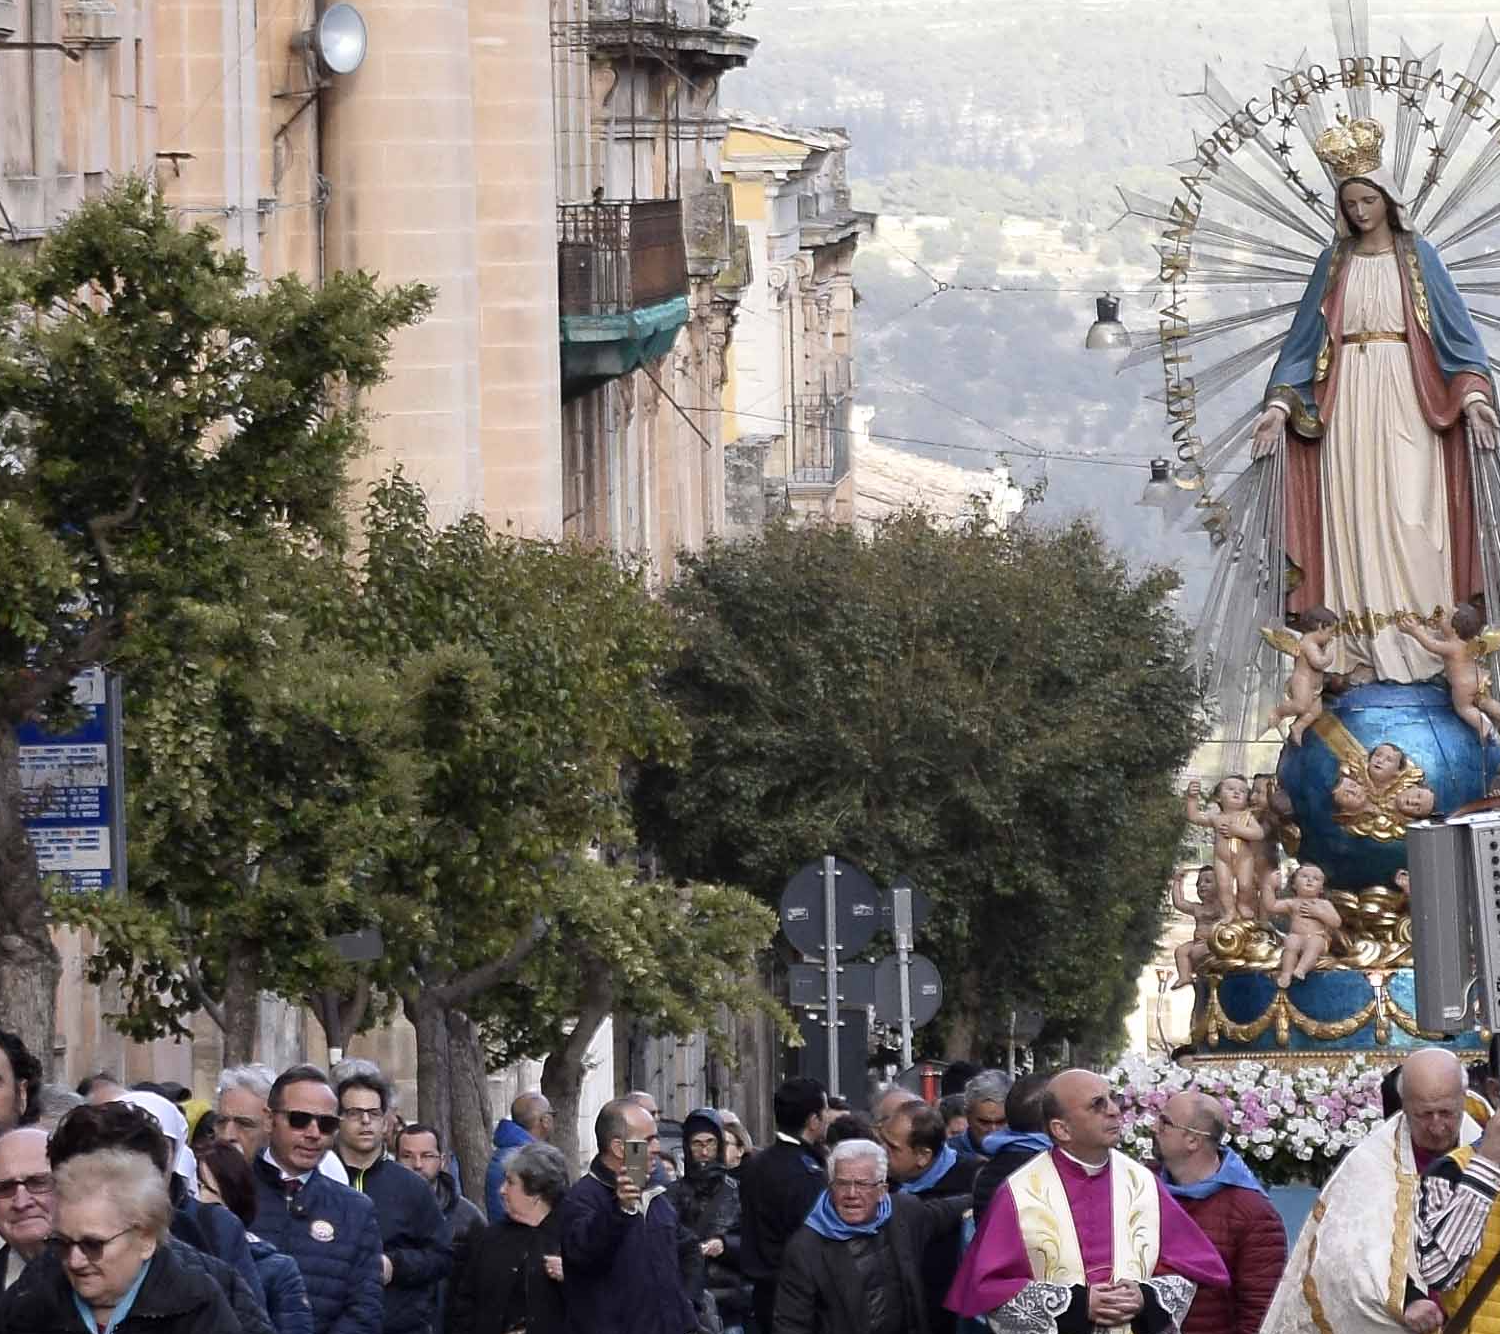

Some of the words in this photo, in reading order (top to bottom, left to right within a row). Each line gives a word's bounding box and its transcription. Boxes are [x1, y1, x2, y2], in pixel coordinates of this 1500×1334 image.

[1160, 175, 1211, 284] SENZA
[1198, 65, 1327, 174] PECCATO
[1340, 55, 1495, 122] PREGATE
